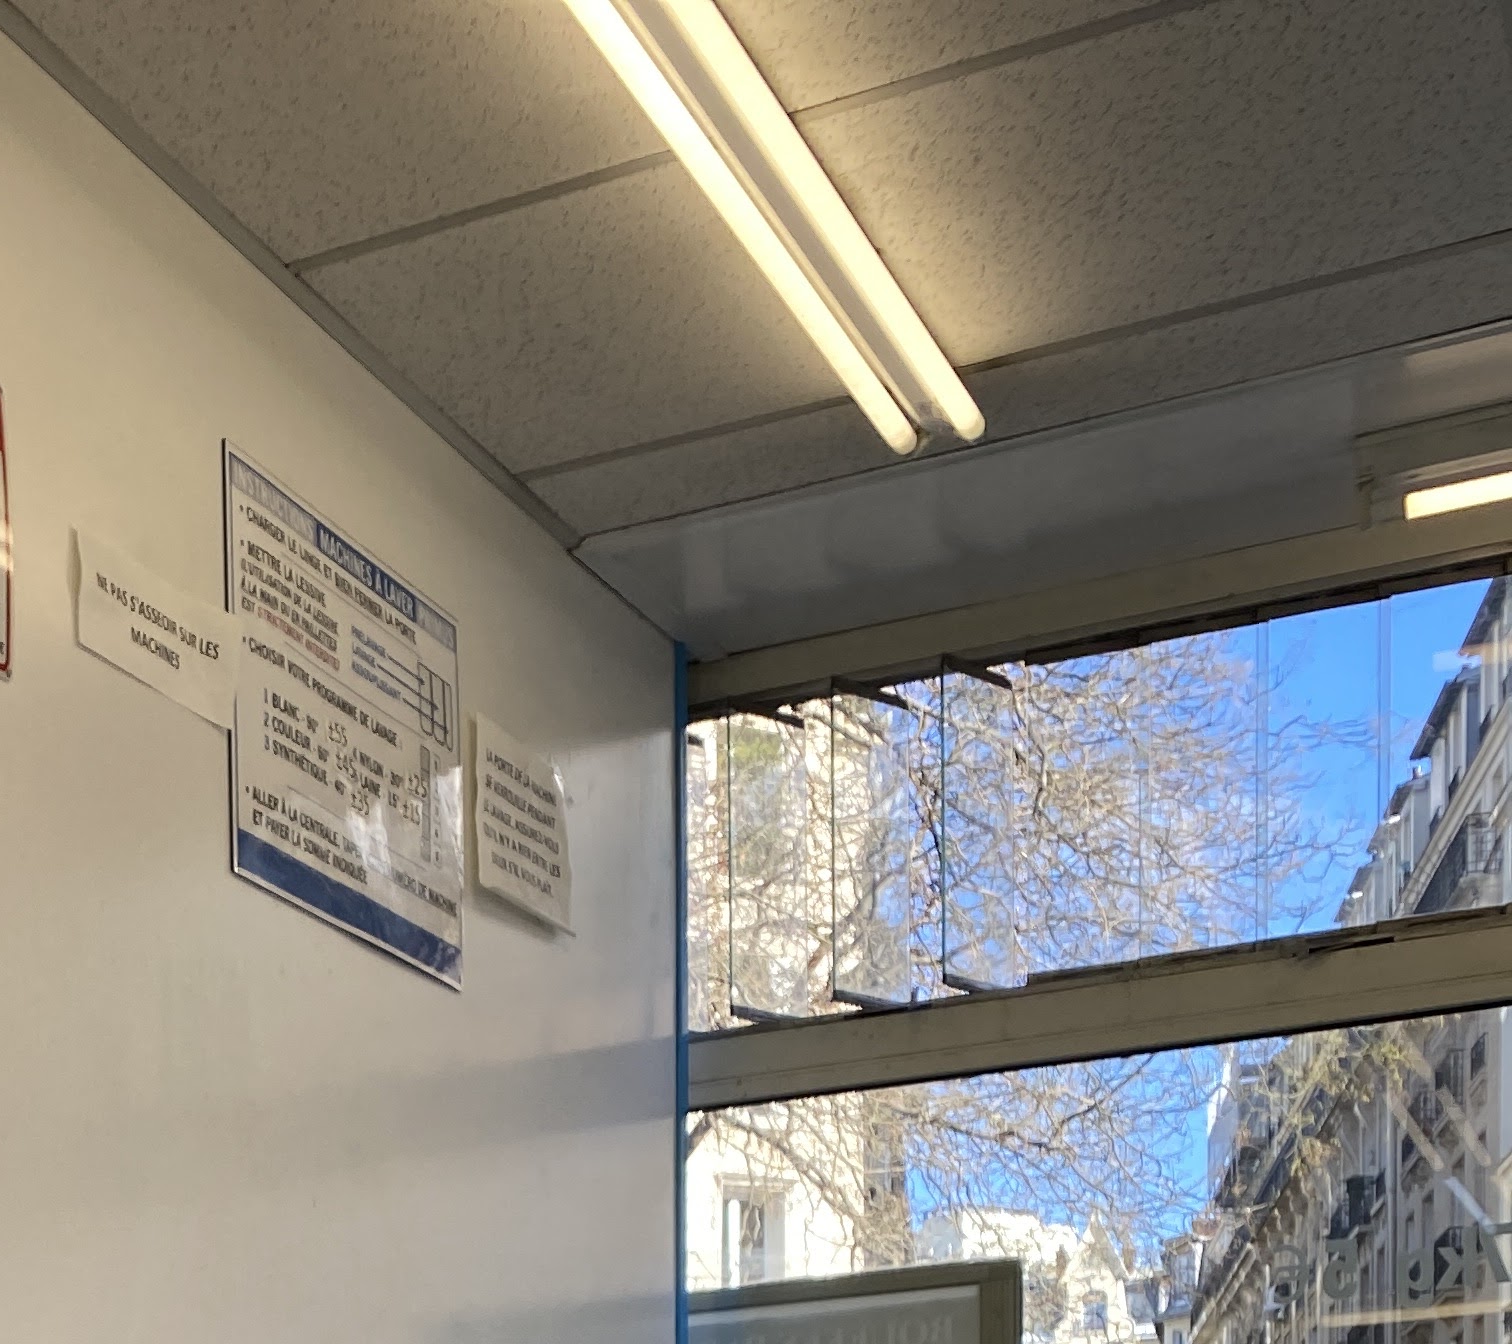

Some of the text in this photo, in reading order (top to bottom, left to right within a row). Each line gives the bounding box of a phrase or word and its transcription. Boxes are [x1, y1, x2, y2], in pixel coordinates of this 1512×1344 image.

[110, 582, 128, 606] PAS
[179, 626, 197, 650] SUR
[199, 638, 219, 660] LES
[131, 627, 180, 670] MACHINES
[252, 786, 278, 811] ALLER
